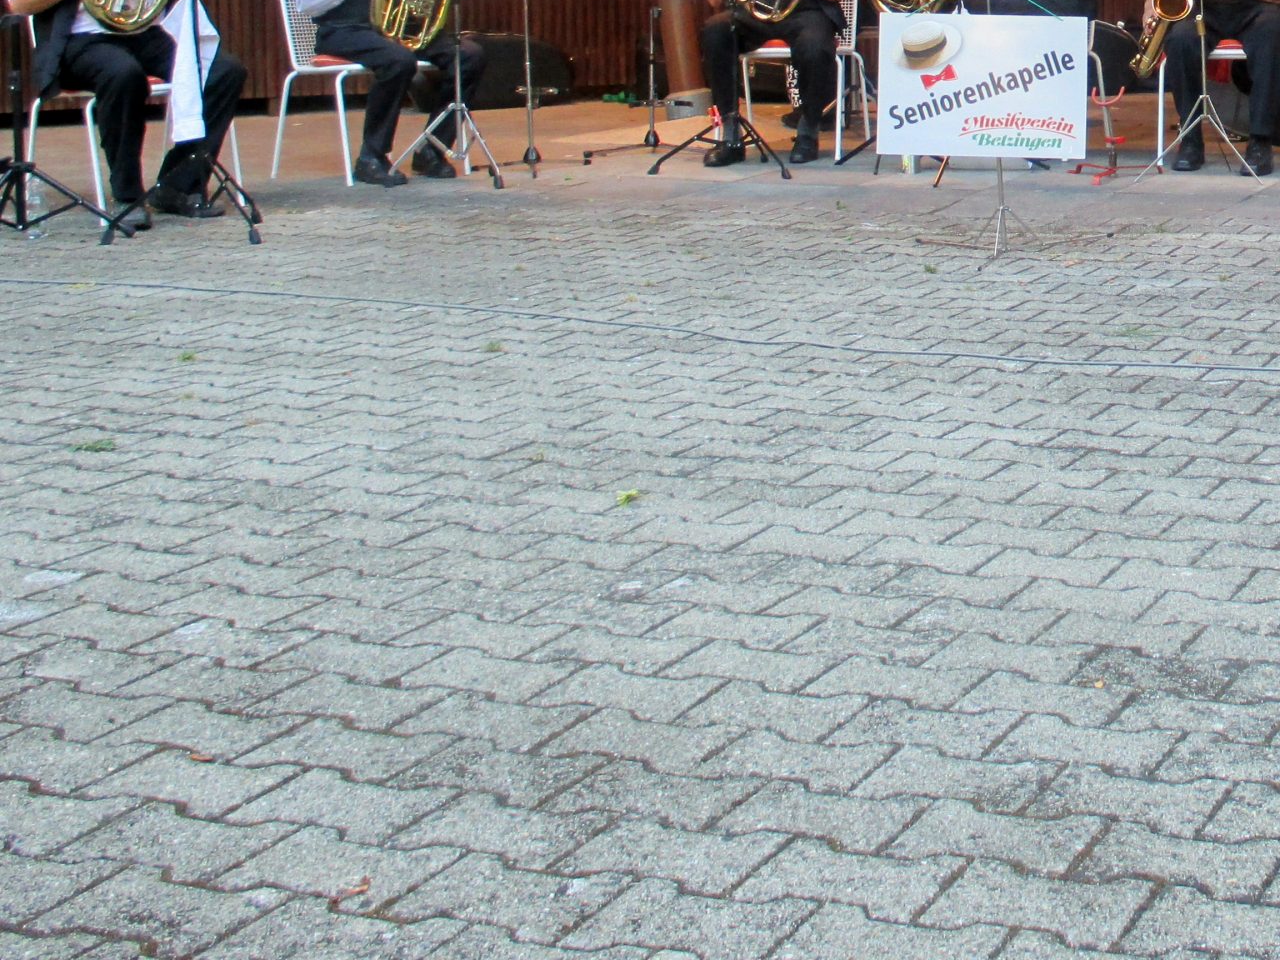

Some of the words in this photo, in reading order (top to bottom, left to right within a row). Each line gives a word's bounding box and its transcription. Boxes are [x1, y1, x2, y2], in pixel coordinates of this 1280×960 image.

[889, 50, 1075, 130] Seniorenkapelle
[961, 112, 1075, 134] Musikverein
[972, 132, 1063, 151] Betzingen
